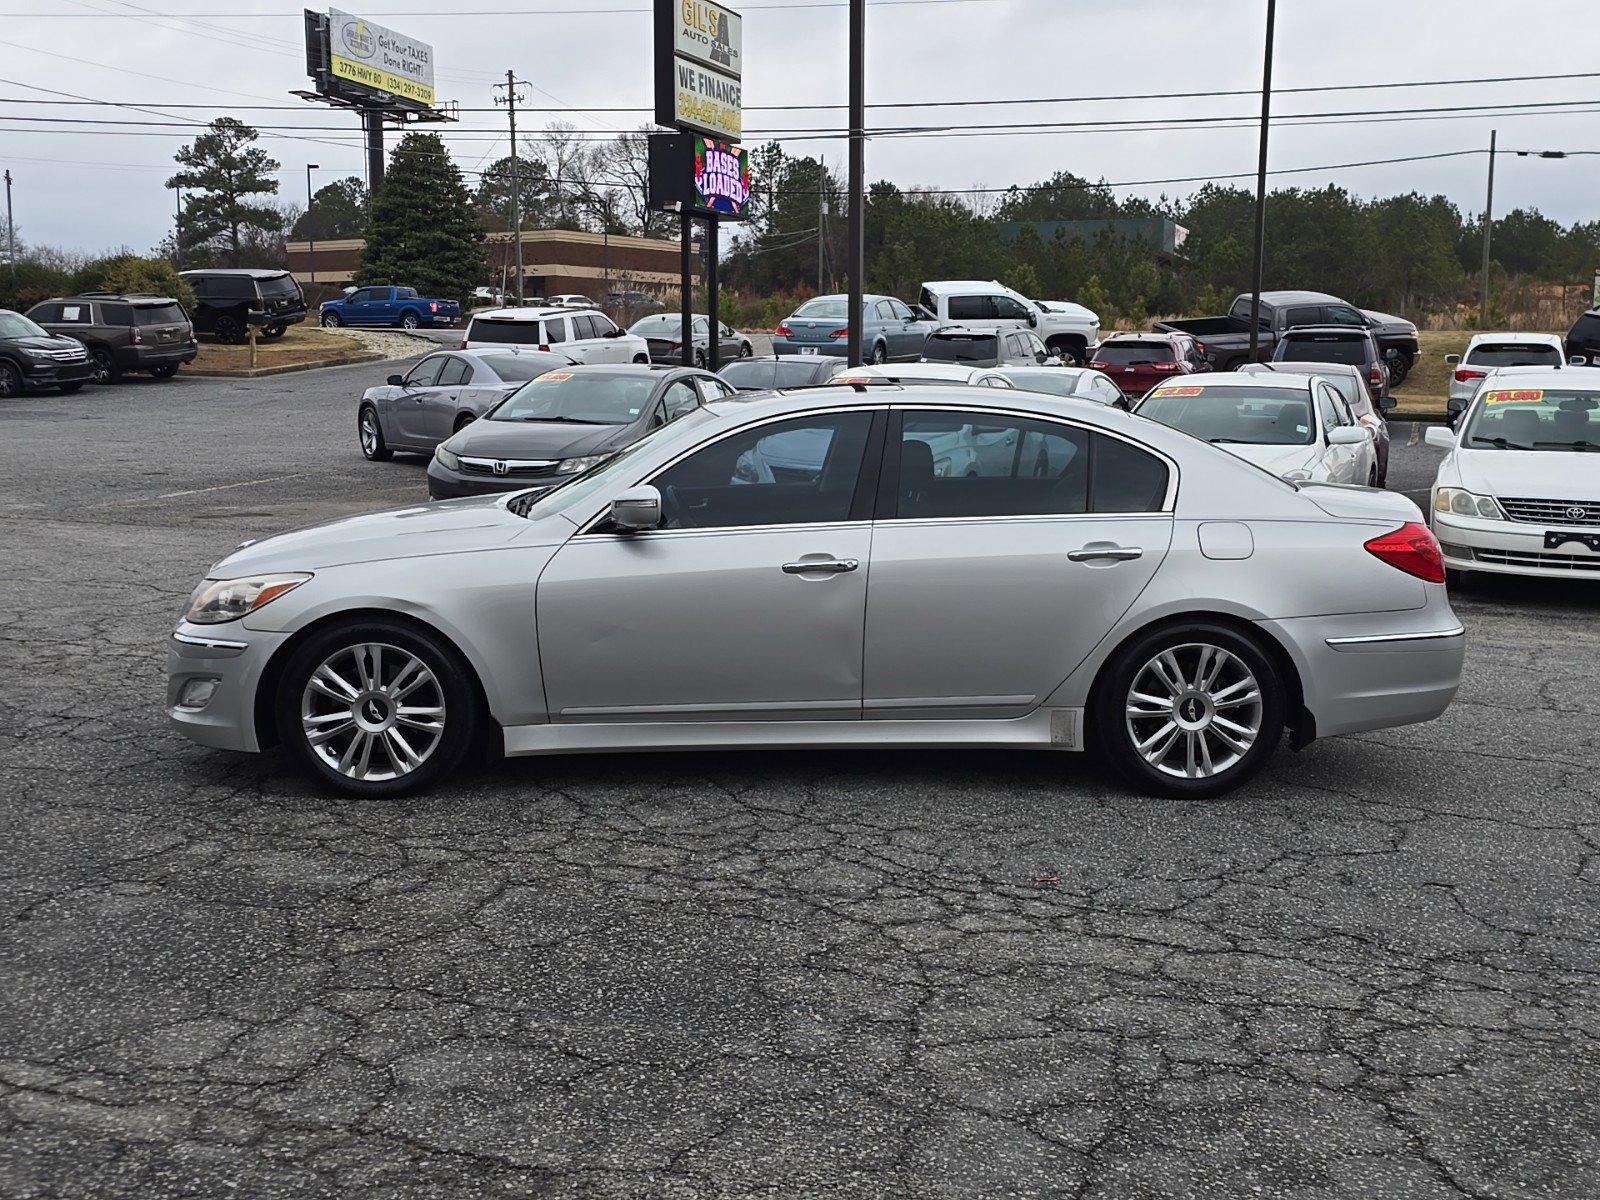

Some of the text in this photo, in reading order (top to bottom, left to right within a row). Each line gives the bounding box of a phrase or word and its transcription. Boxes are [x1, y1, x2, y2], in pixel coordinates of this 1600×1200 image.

[681, 0, 718, 37] GIL'S
[378, 34, 391, 50] Get
[391, 38, 407, 54] Your
[407, 45, 428, 63] TAXES
[682, 28, 739, 58] AUTO SALES
[339, 61, 357, 77] 3776
[357, 67, 373, 82] HWY
[373, 72, 382, 85] 80
[387, 76, 403, 94] (334)
[383, 52, 424, 77] Done RIGHT!
[678, 64, 741, 108] WE FINANCE
[705, 150, 740, 181] BASES
[702, 172, 743, 204] LOADED
